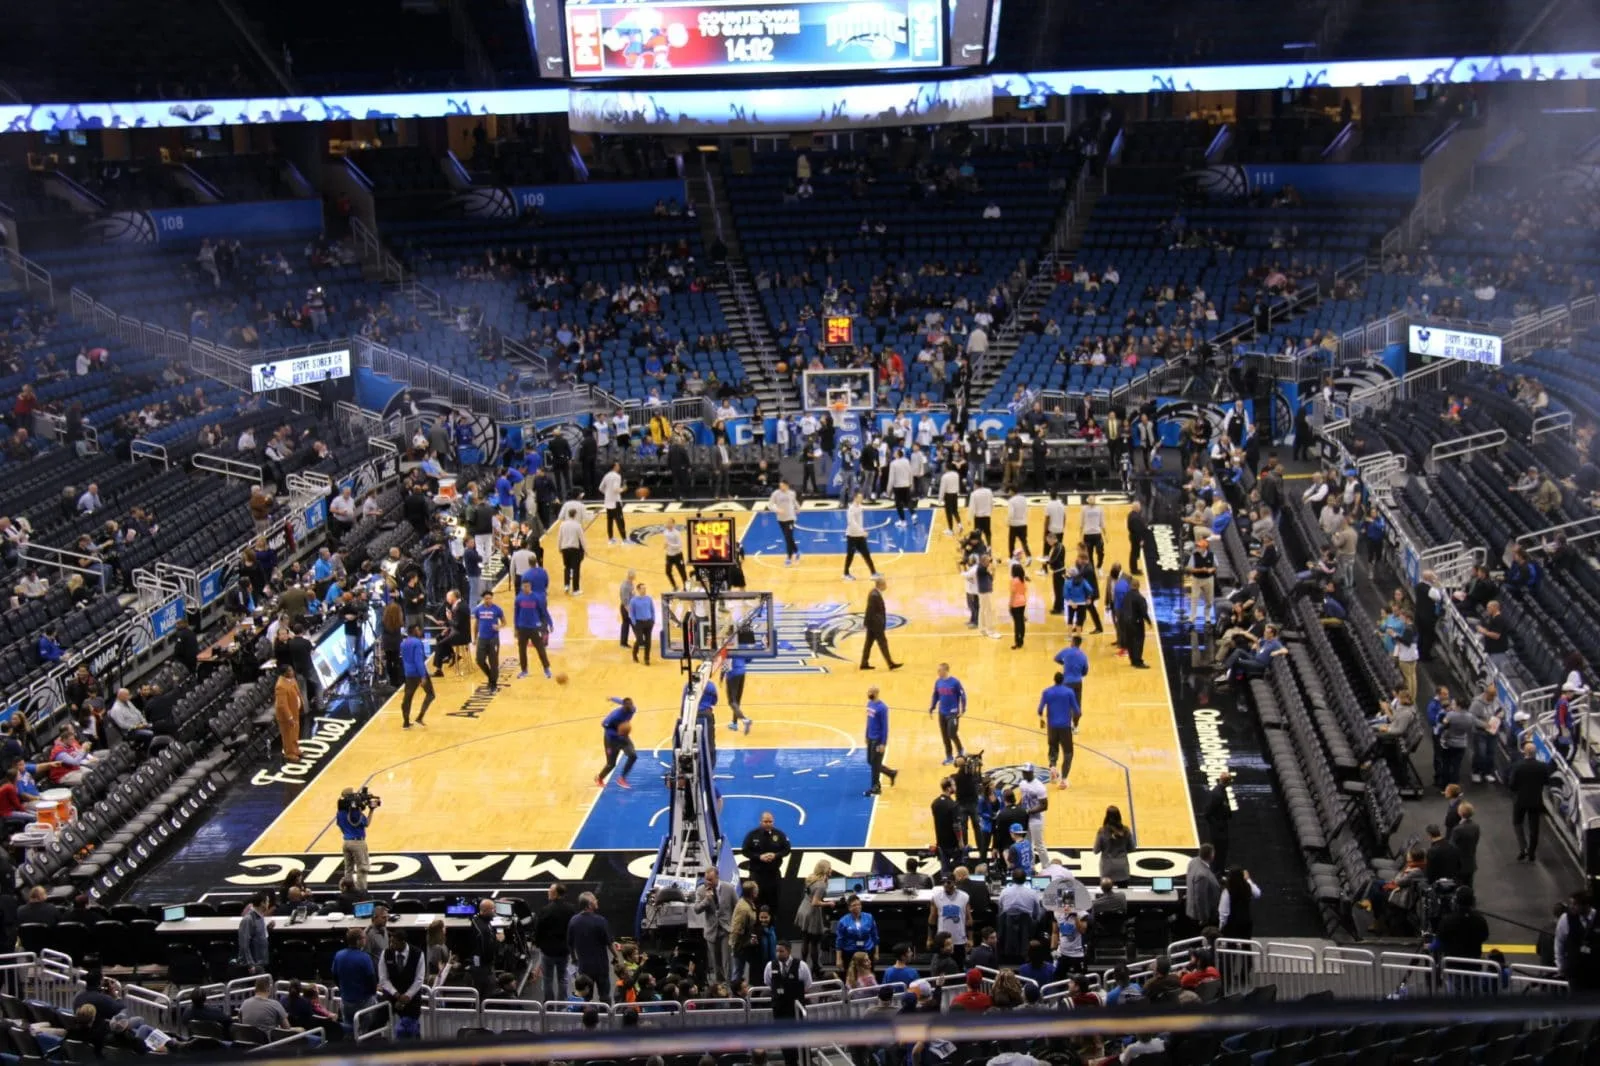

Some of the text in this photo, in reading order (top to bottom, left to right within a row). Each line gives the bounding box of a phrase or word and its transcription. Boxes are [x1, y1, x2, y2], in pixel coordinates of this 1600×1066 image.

[1255, 171, 1274, 185] 111
[523, 193, 545, 206] 109
[161, 215, 184, 230] 108
[828, 328, 849, 342] 24
[696, 537, 726, 559] 24
[251, 716, 357, 786] FanDuel
[225, 850, 1192, 885] ORAN MAGIC
